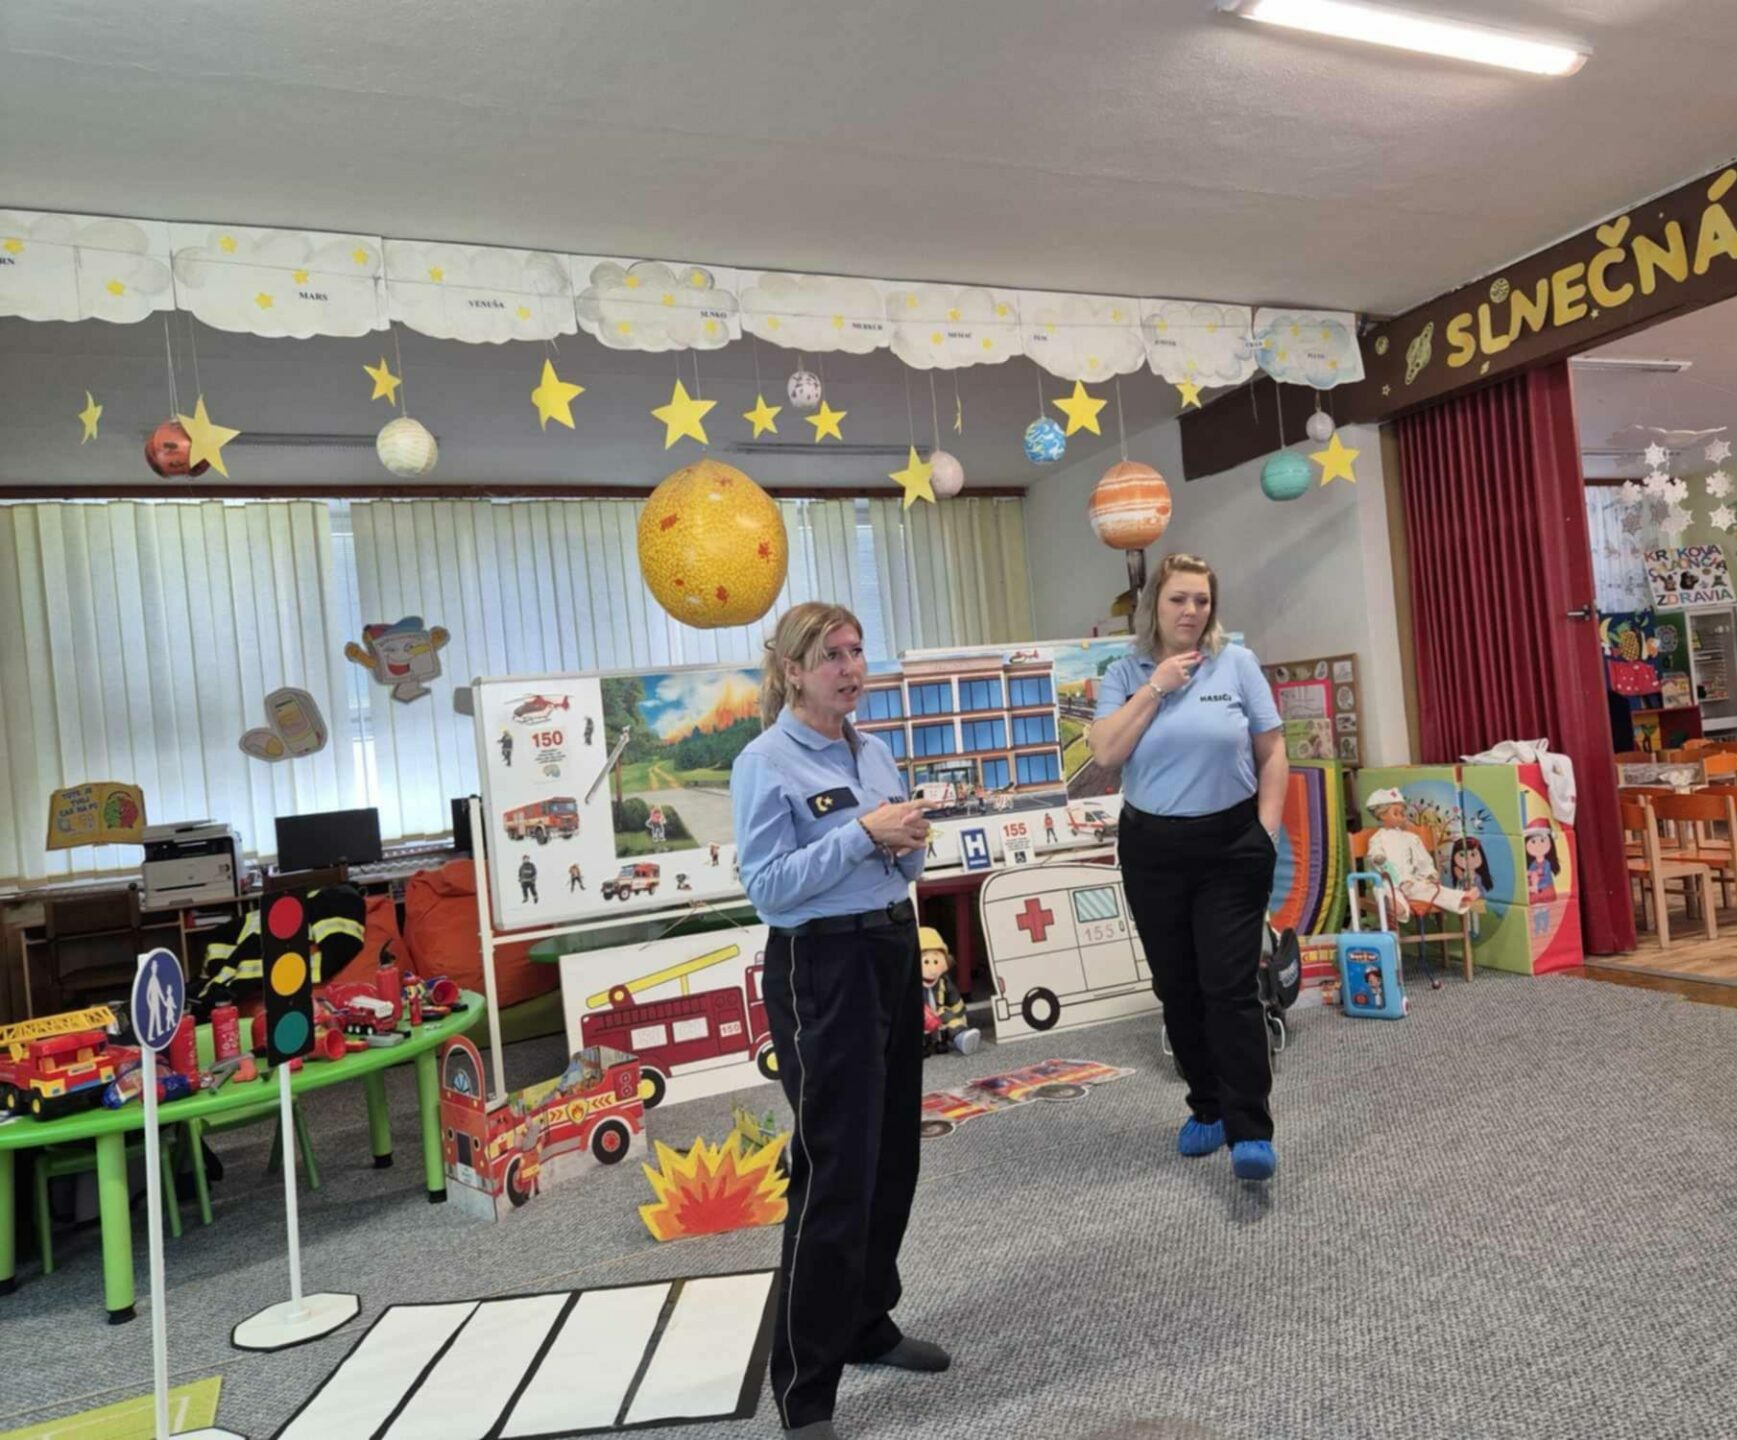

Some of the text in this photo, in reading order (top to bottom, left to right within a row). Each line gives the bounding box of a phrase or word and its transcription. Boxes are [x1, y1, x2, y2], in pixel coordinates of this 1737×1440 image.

[1446, 168, 1737, 368] SLNEČNÁ
[299, 291, 328, 301] MARS
[1656, 588, 1733, 606] ZDRAVIA
[532, 730, 563, 748] 150
[1003, 822, 1027, 838] 155
[964, 833, 987, 858] H
[1084, 924, 1116, 942] 155
[721, 1023, 740, 1035] 150
